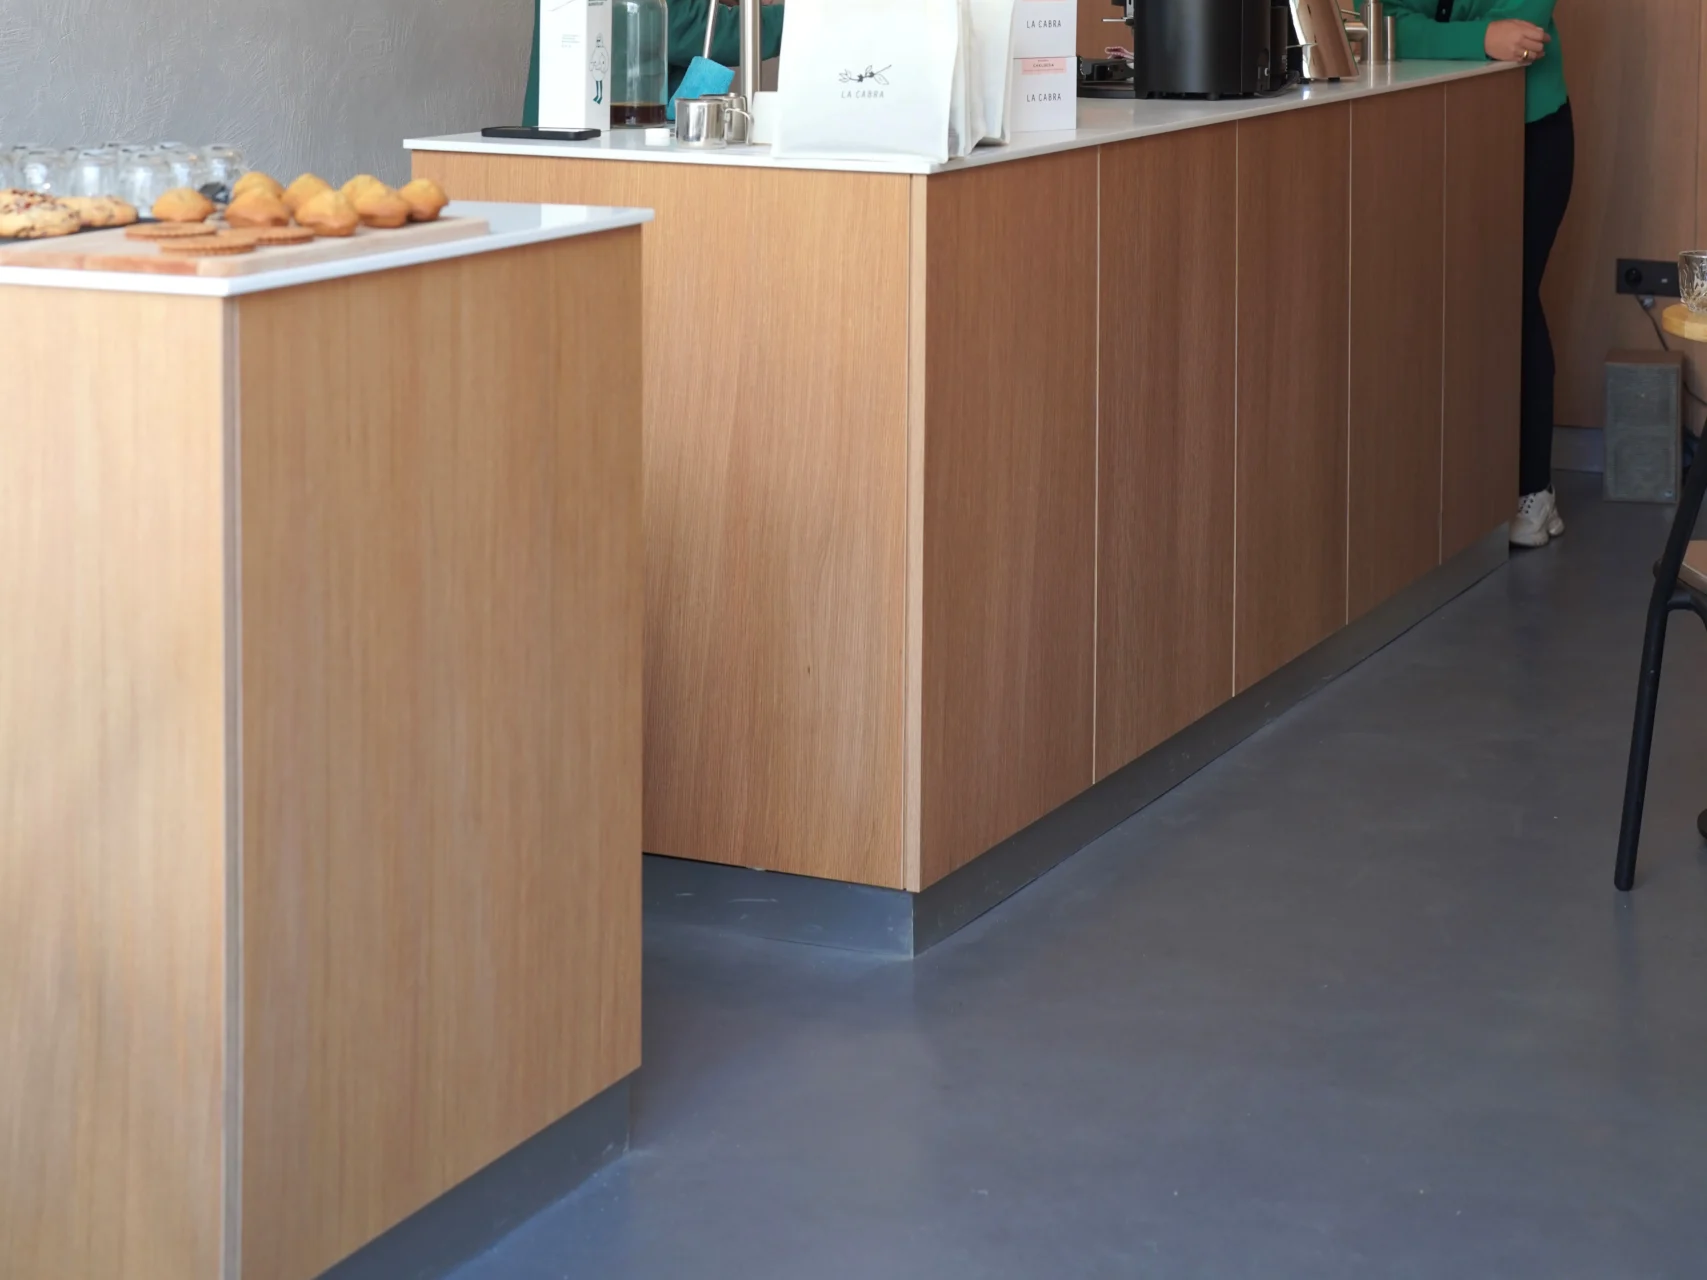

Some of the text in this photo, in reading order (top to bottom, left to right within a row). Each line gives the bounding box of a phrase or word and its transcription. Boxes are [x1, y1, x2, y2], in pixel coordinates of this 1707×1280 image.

[1027, 20, 1062, 29] LA CABRA
[841, 90, 884, 99] LA CABRA
[1027, 93, 1062, 102] LA CABRA
